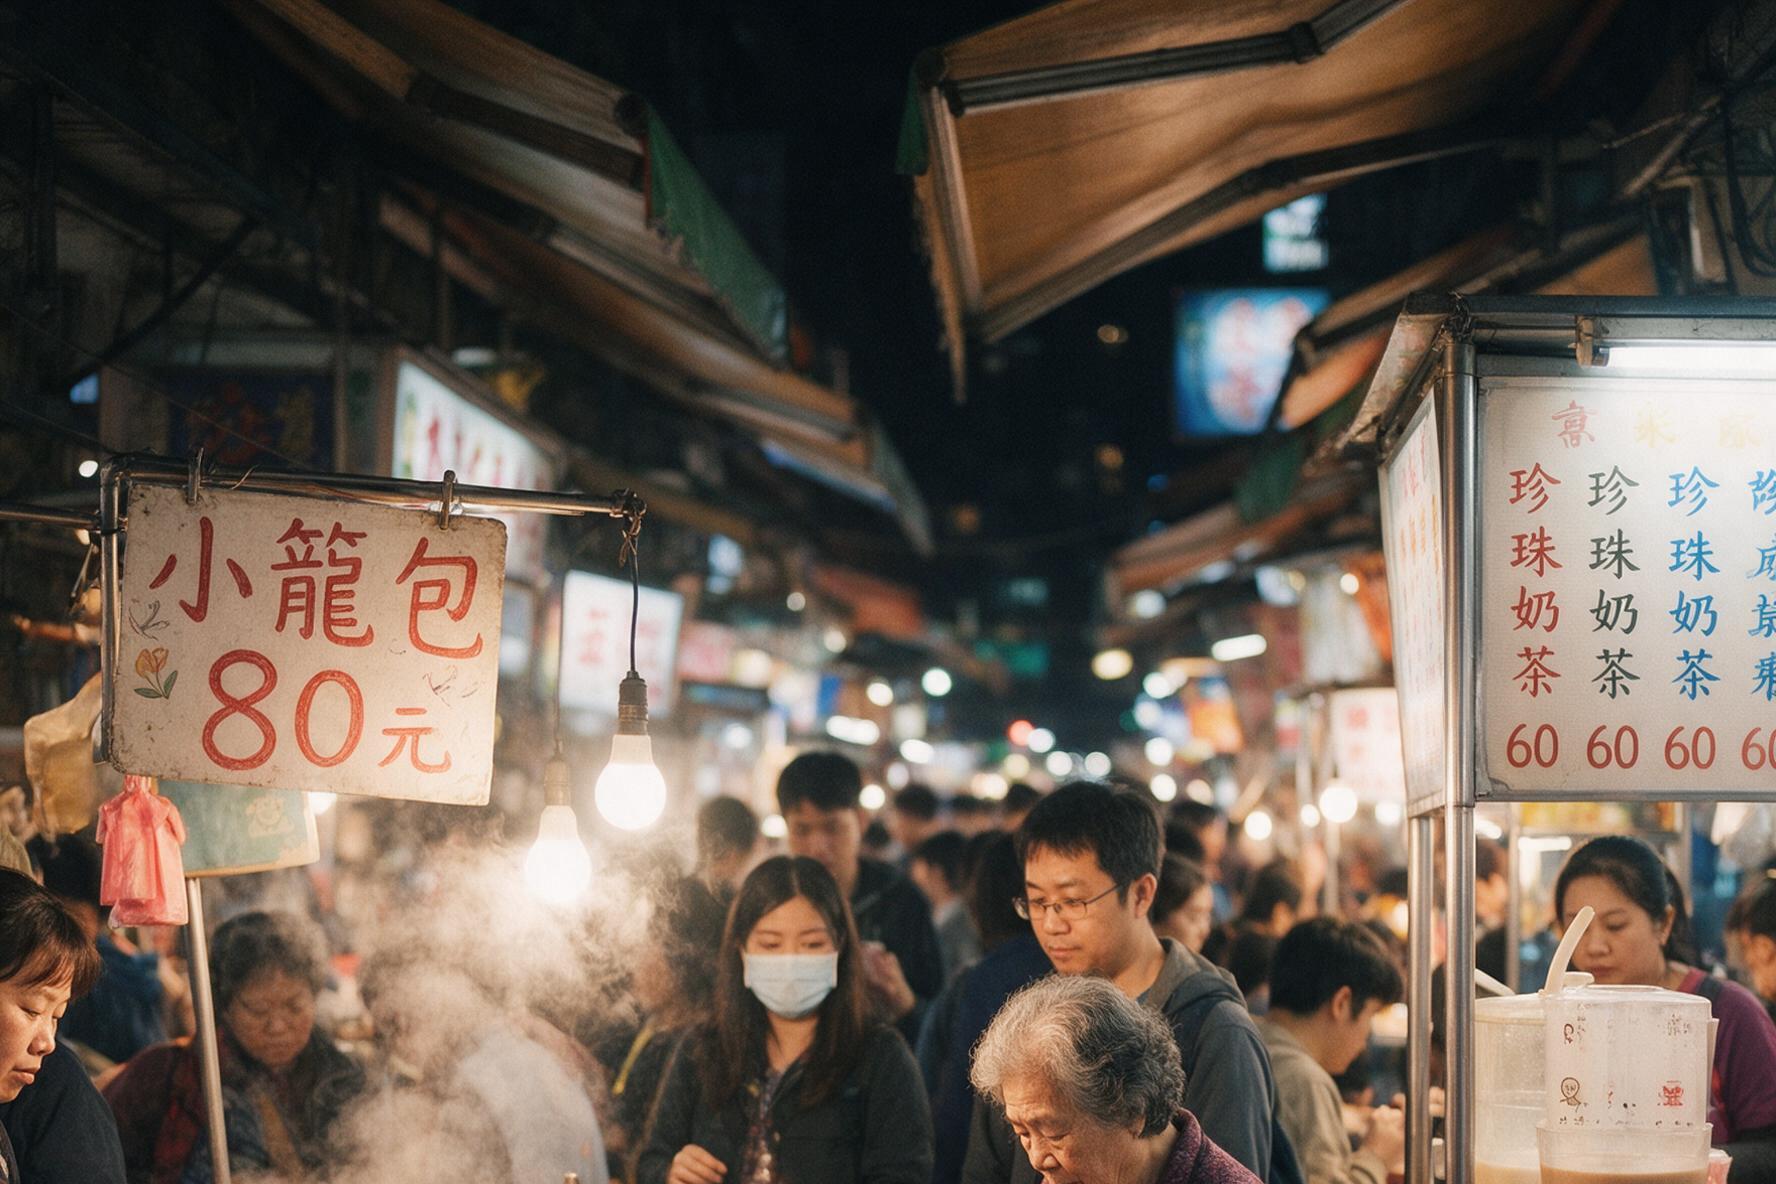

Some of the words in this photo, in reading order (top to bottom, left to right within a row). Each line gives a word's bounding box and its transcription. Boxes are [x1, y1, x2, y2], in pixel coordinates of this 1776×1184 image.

[149, 516, 484, 660] 小籠包
[1508, 462, 1563, 699] 珍珠奶茶
[1587, 465, 1641, 701] 珍珠奶茶
[1667, 465, 1722, 702] 珍珠奶茶
[1506, 723, 1559, 770] 60
[1586, 724, 1640, 770] 60
[1664, 725, 1717, 771] 60
